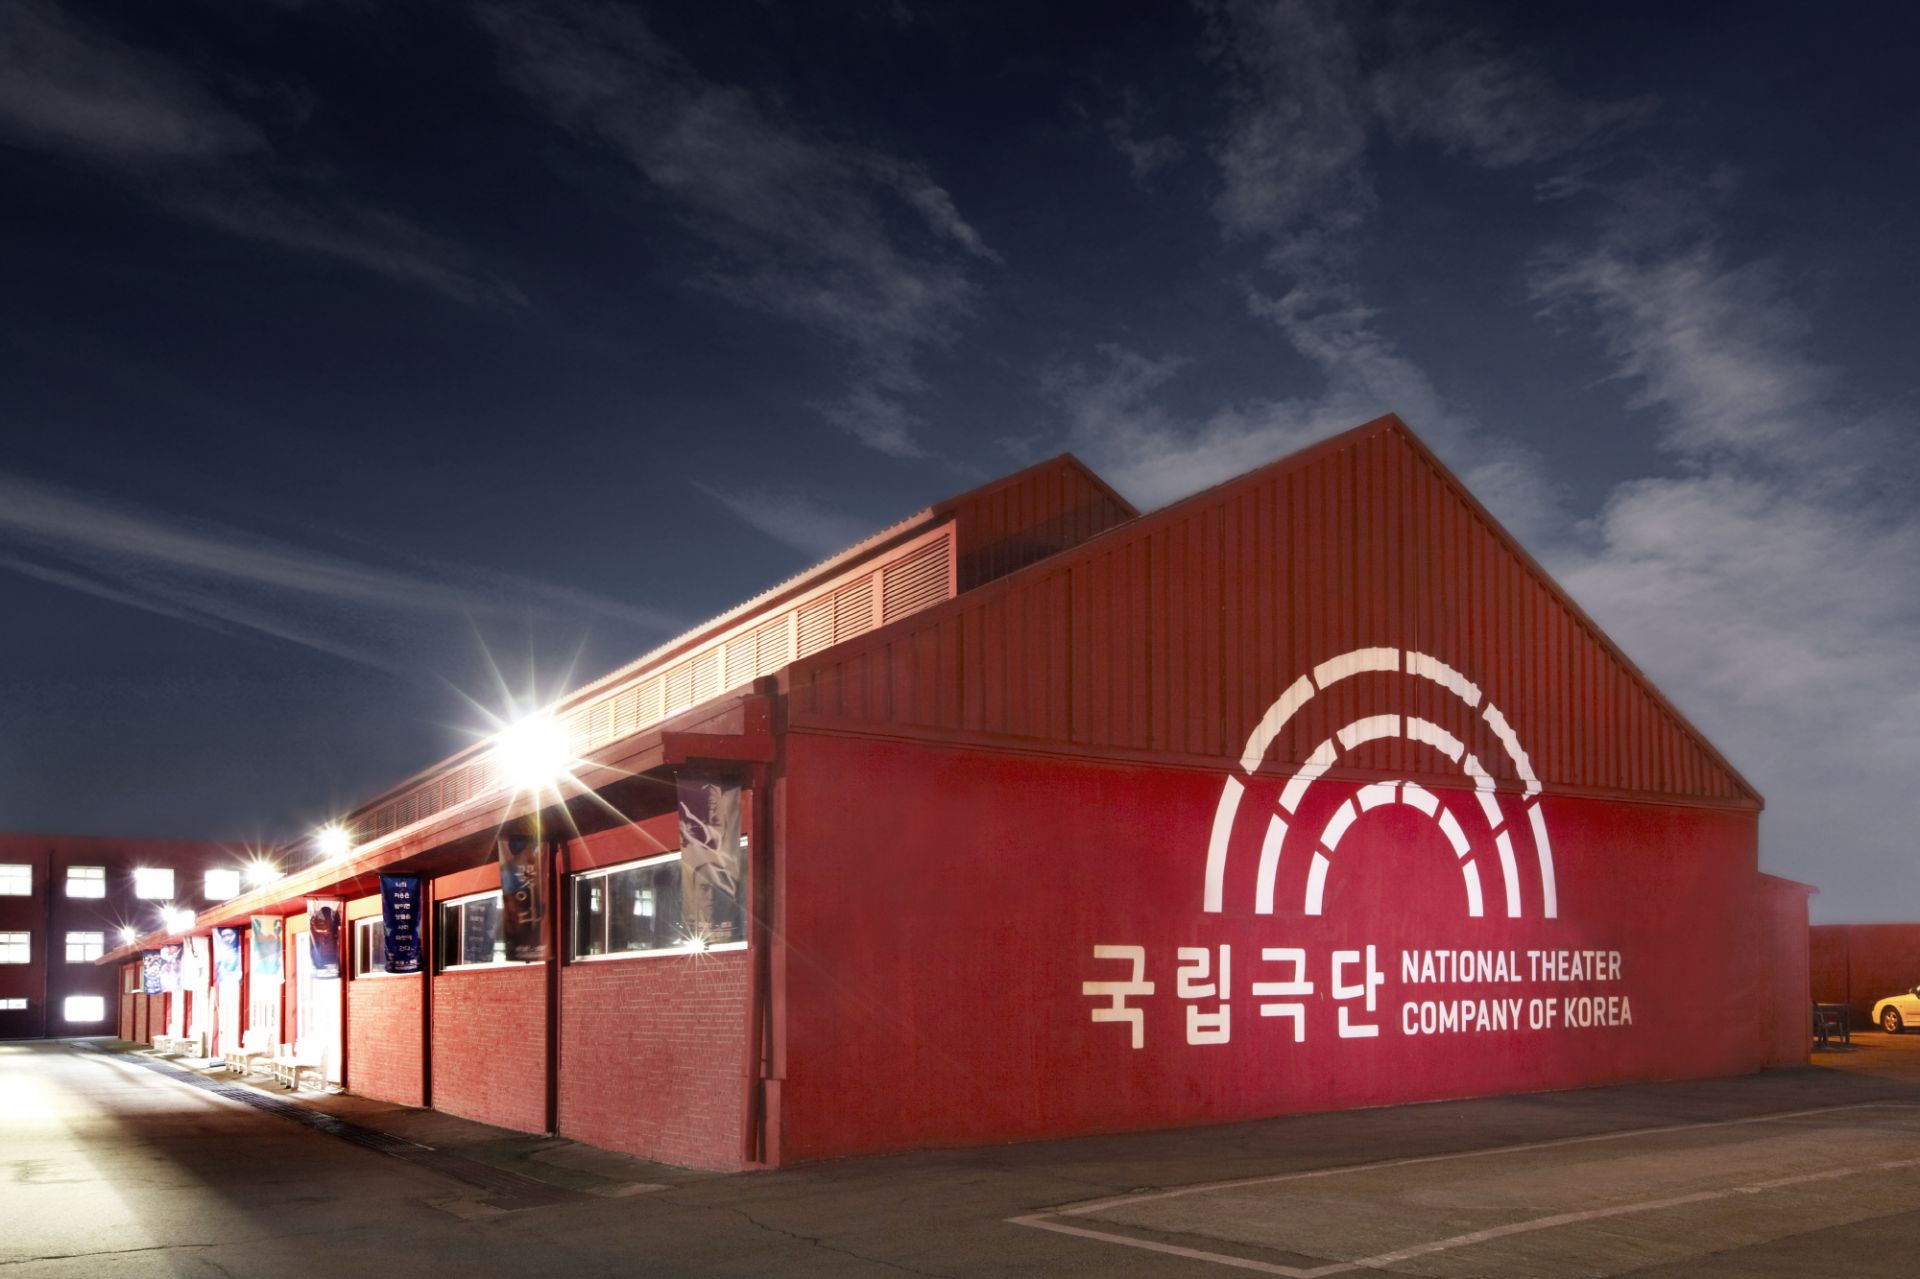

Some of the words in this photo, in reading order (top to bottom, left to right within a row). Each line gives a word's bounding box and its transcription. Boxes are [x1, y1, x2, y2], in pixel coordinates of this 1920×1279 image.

[1402, 950, 1522, 984] NATIONAL
[1527, 950, 1622, 982] THEATER
[1082, 944, 1385, 1049] 국립극단
[1402, 998, 1523, 1036] COMPANY
[1529, 998, 1557, 1030] OF
[1564, 996, 1633, 1028] KOREA
